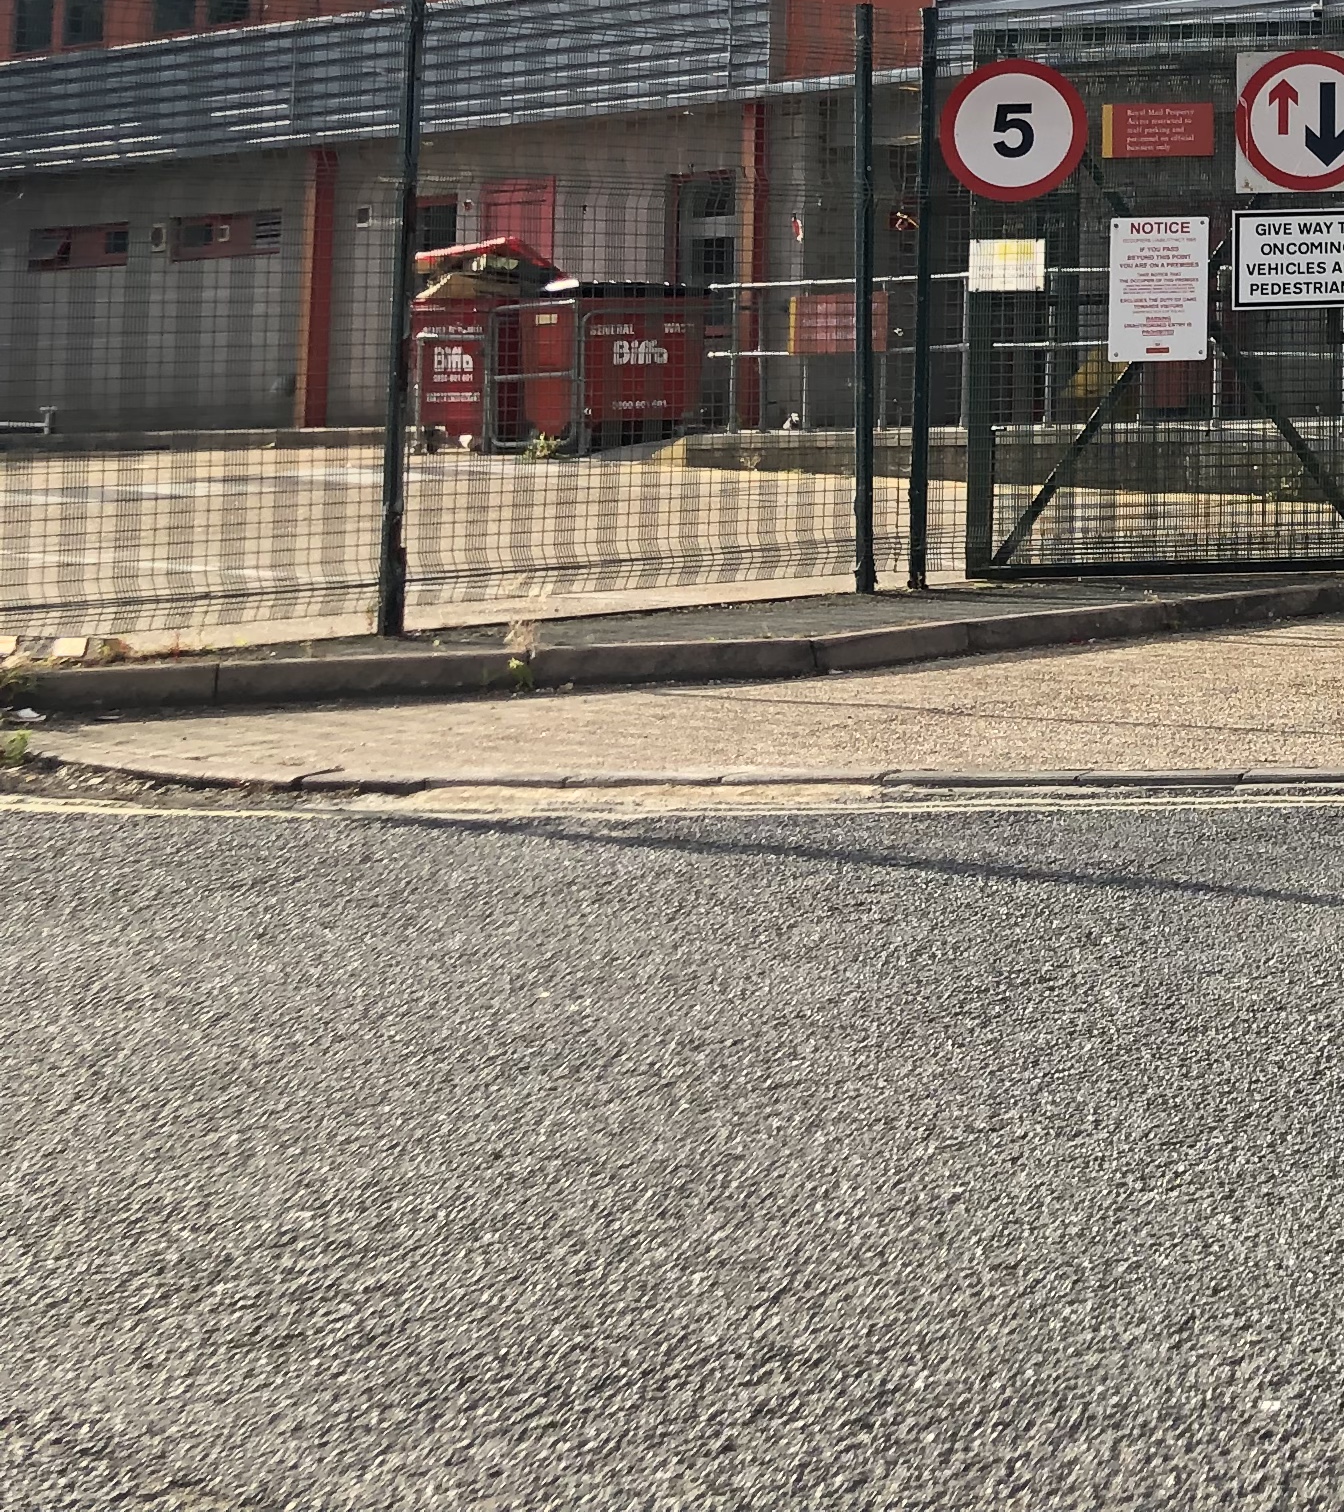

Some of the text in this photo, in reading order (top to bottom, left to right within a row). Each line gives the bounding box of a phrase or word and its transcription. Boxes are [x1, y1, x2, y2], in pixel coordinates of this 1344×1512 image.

[993, 102, 1035, 159] 5
[1130, 222, 1191, 234] NOTICE
[1255, 222, 1292, 236] GIVE
[1298, 221, 1334, 235] WAY
[1246, 261, 1327, 276] VEHICLES
